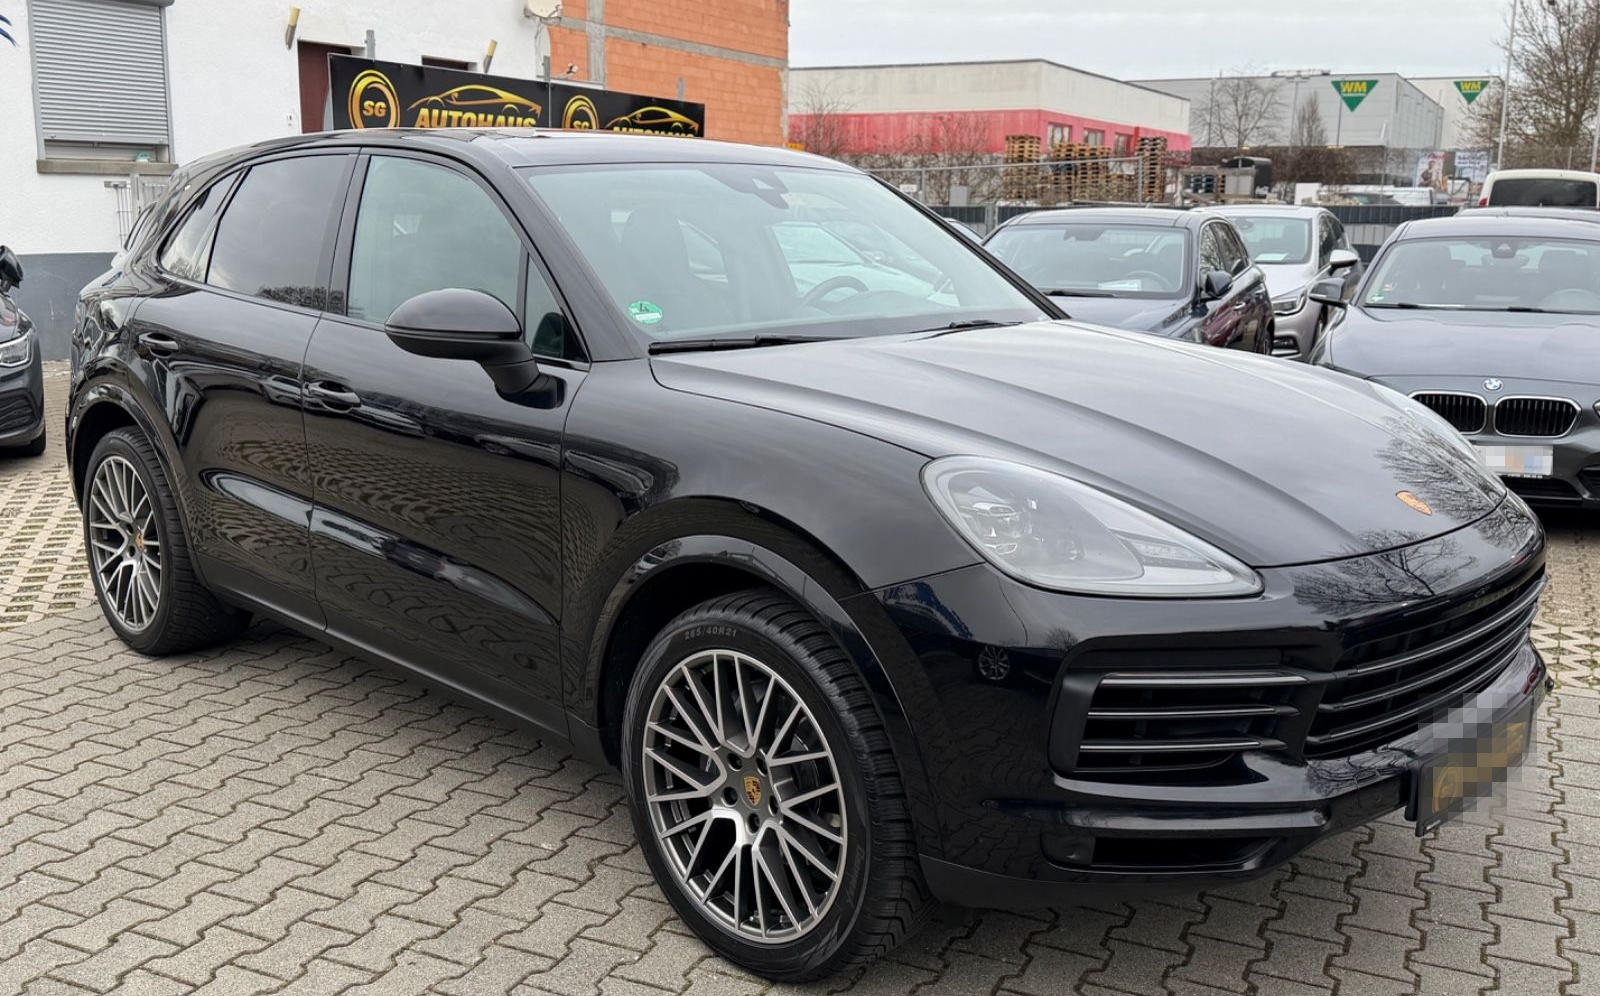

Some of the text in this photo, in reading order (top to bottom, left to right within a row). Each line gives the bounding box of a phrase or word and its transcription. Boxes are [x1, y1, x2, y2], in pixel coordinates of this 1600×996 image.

[1341, 81, 1367, 93] WM
[1461, 81, 1481, 91] WM
[363, 100, 387, 117] SG
